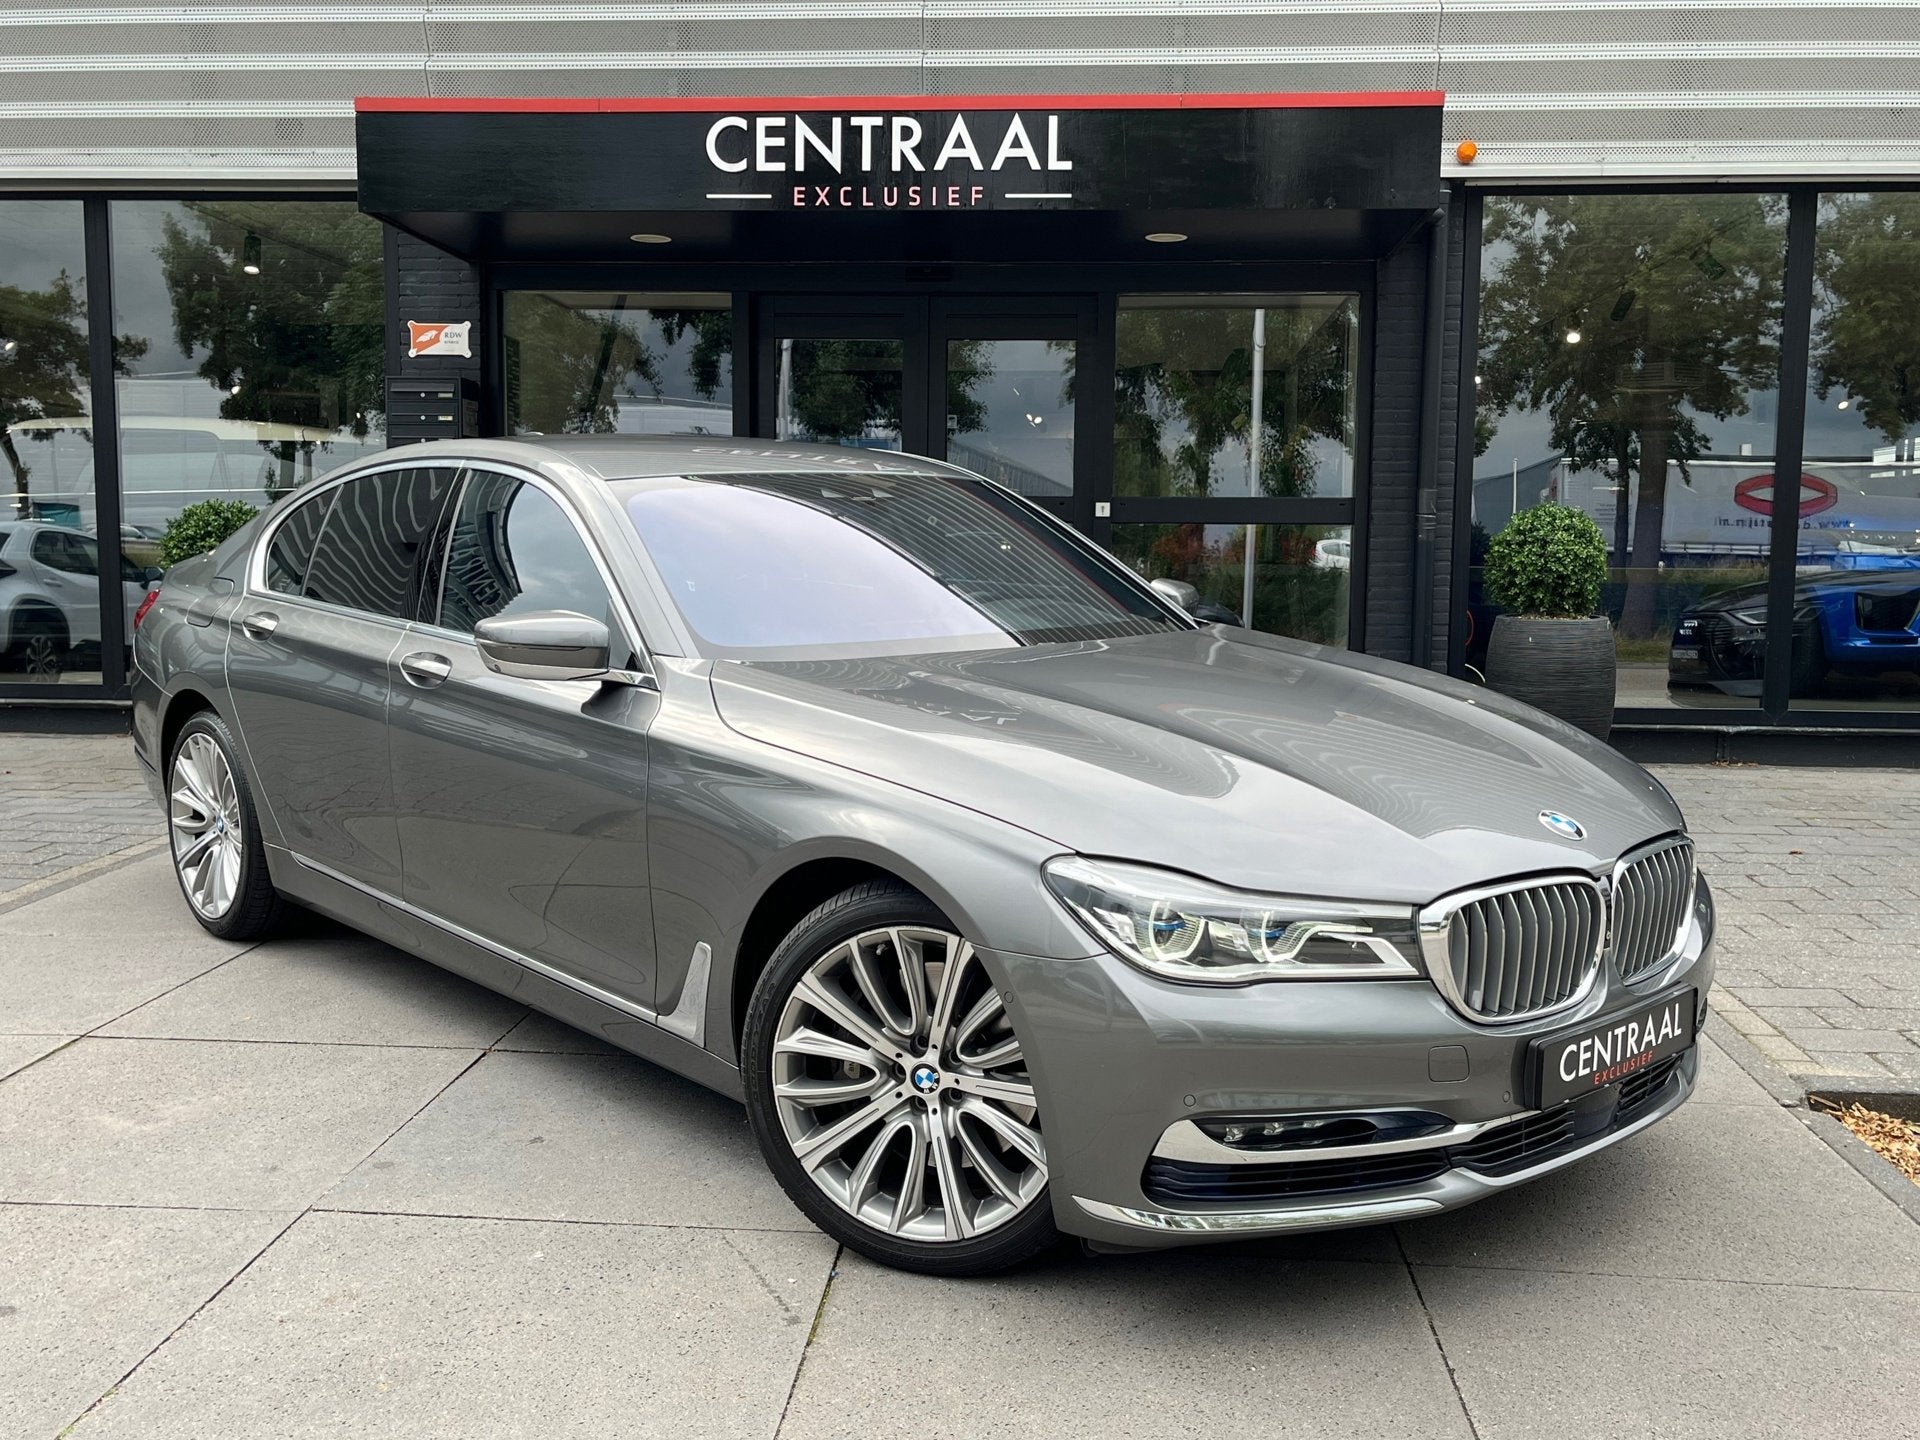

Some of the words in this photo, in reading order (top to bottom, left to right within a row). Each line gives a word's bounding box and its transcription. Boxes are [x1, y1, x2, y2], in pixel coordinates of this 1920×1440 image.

[705, 112, 1073, 175] CENTRAAL
[793, 186, 984, 206] EXCLUSIEF
[1559, 1003, 1682, 1082] CENTRAAL
[1594, 1050, 1654, 1085] EXCLUSIEF
